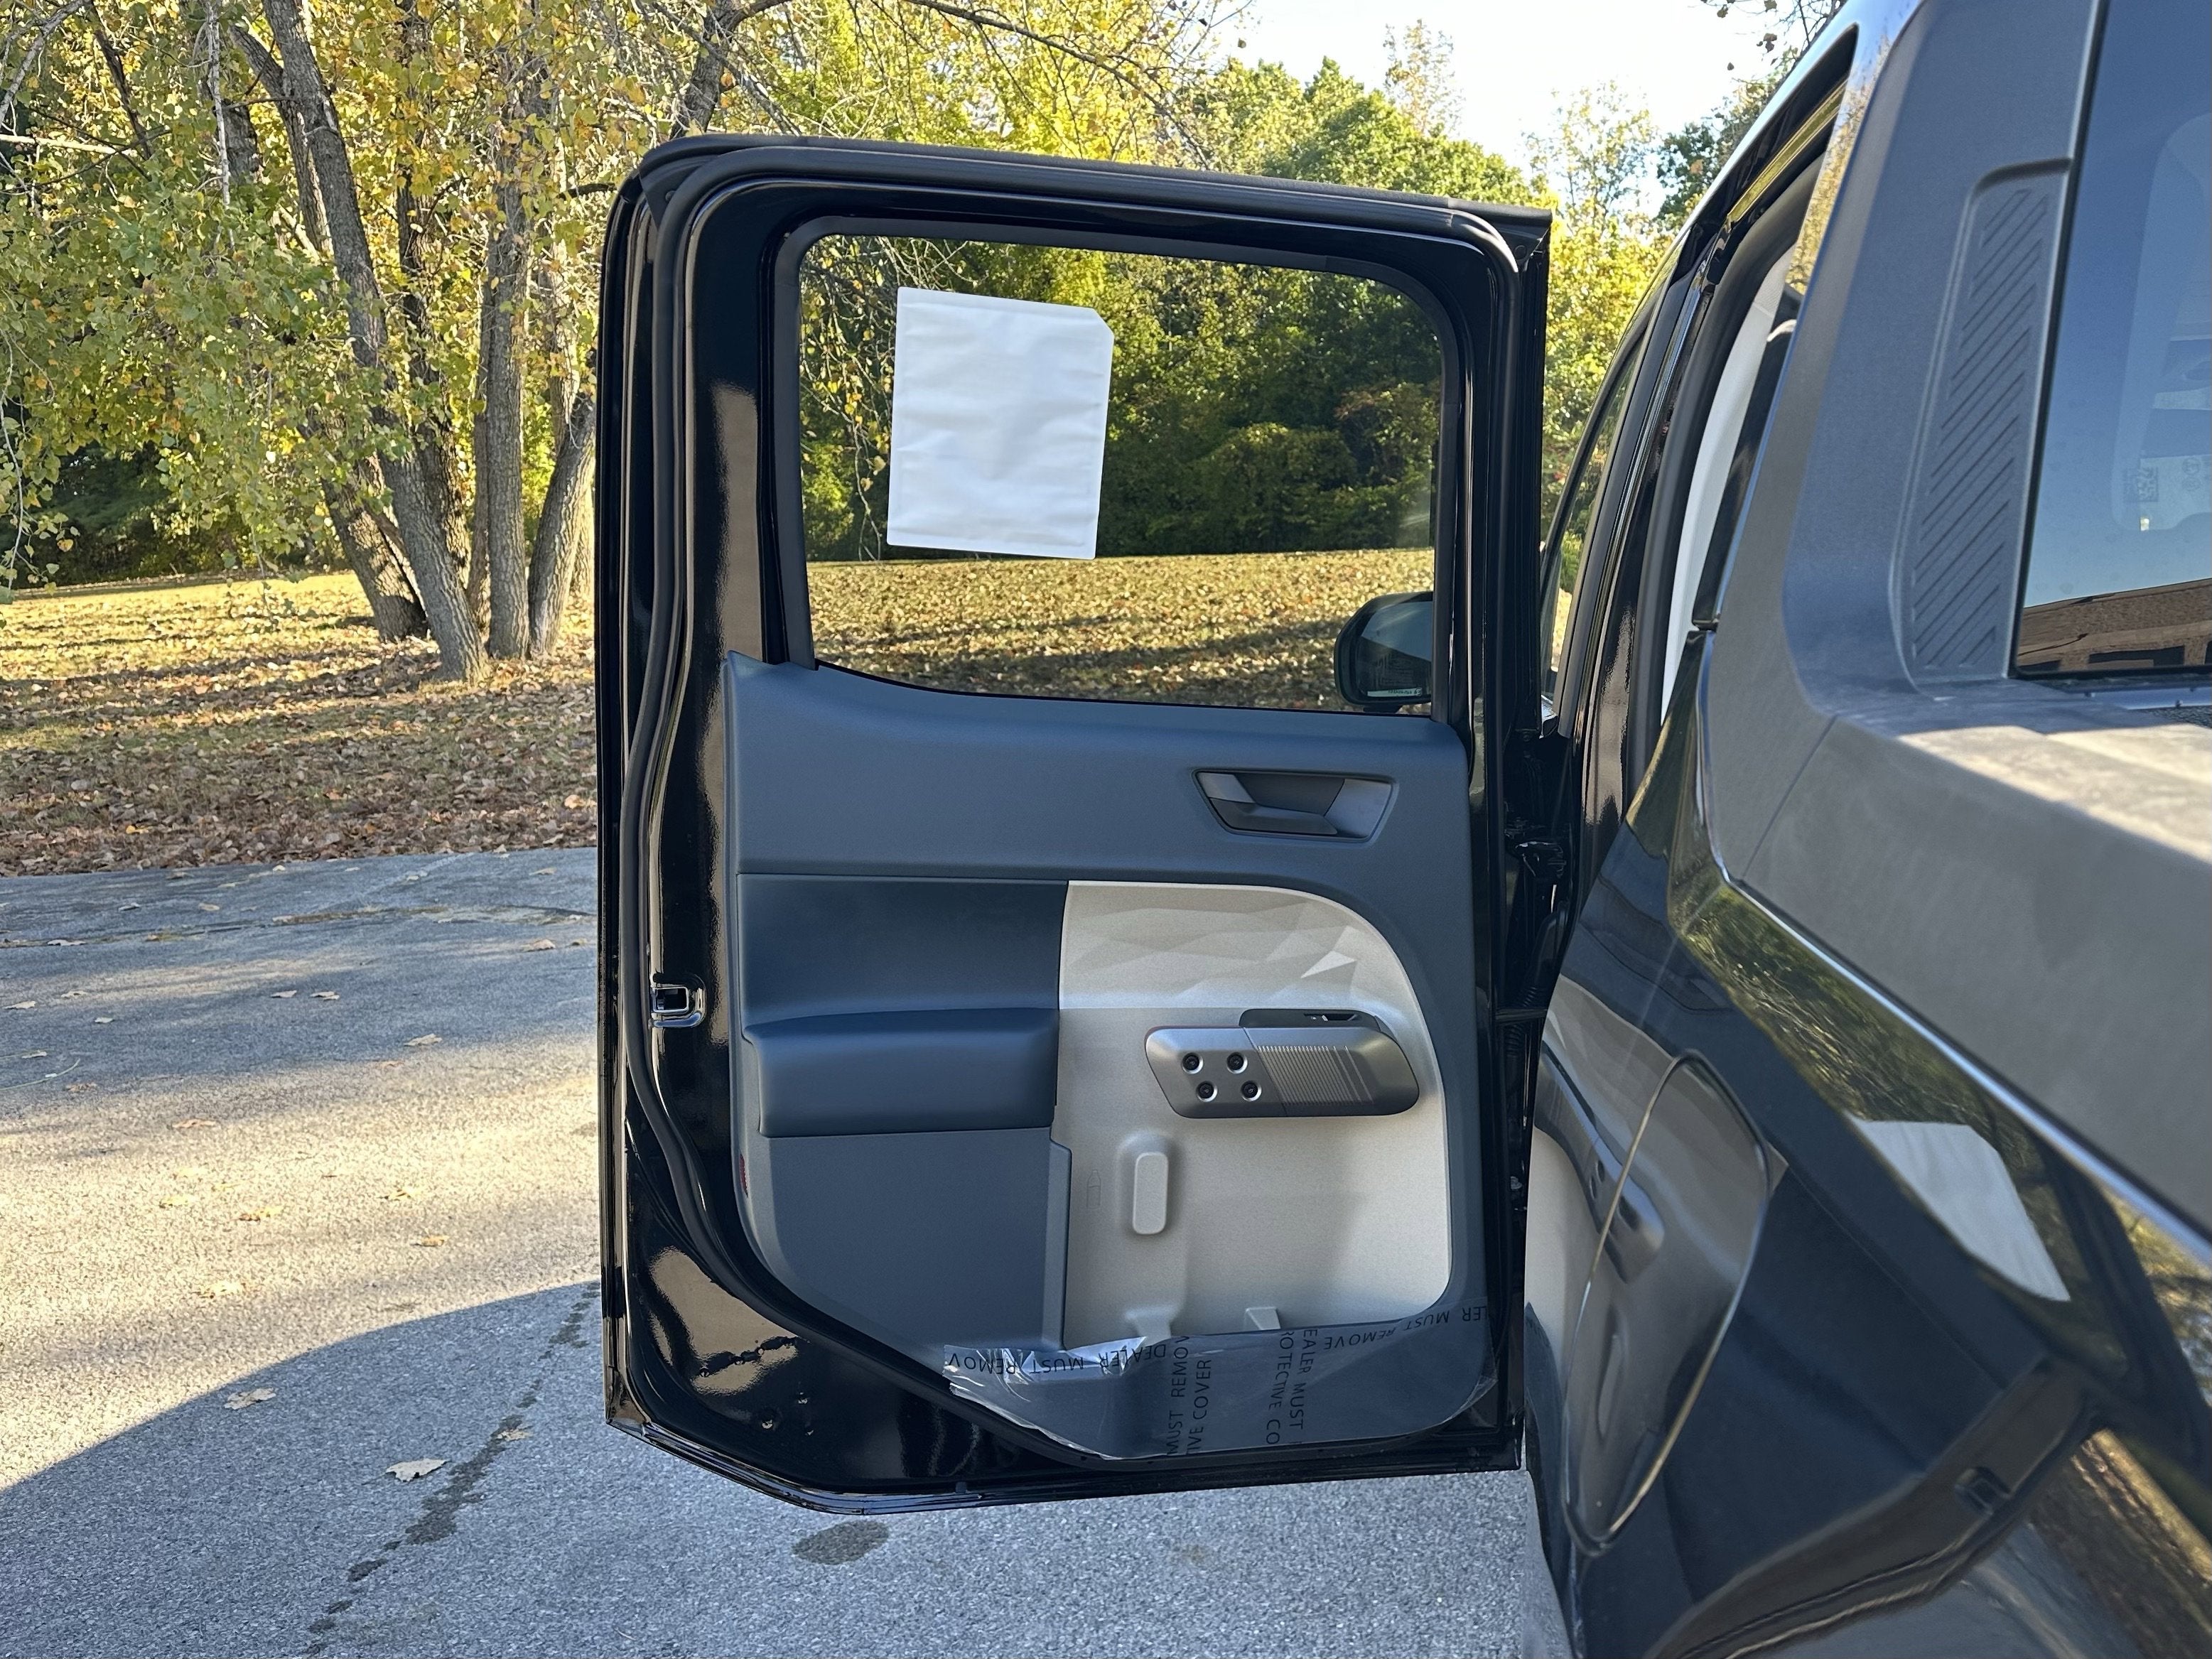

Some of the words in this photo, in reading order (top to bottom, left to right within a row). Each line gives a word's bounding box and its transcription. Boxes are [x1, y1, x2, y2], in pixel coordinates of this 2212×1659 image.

[1406, 1310, 1450, 1331] MUST
[1324, 1326, 1396, 1350] REMOVE
[1031, 1357, 1084, 1374] MUST
[1099, 1344, 1166, 1368] DEALER
[1193, 1359, 1212, 1420] COVER
[1289, 1383, 1307, 1430] MUST
[1166, 1410, 1184, 1455] MUST
